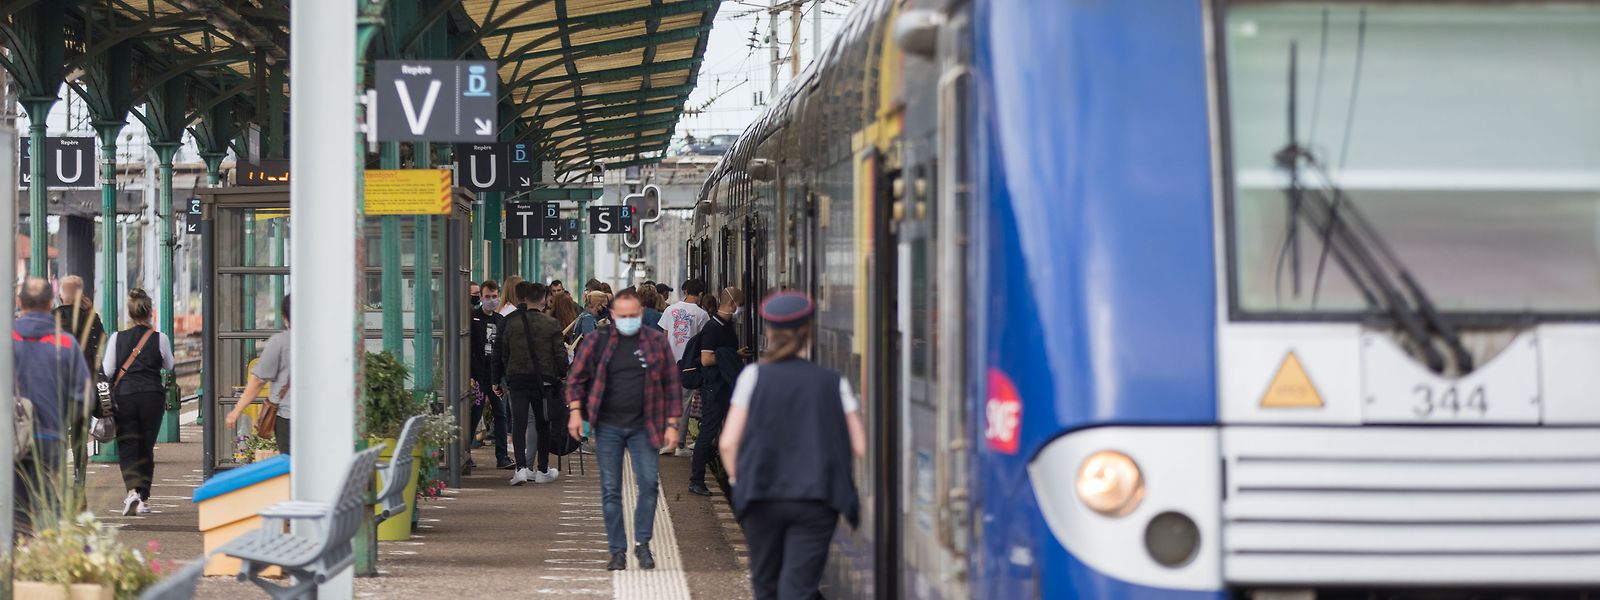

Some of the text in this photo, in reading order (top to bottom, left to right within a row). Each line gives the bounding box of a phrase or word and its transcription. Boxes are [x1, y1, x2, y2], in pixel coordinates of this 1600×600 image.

[468, 74, 487, 92] D
[394, 80, 442, 135] V
[515, 149, 526, 160] D
[56, 149, 82, 183] U
[470, 154, 497, 188] U
[192, 204, 200, 212] C
[547, 208, 556, 216] D
[516, 211, 534, 236] T
[598, 212, 612, 232] S
[1411, 385, 1488, 417] 344
